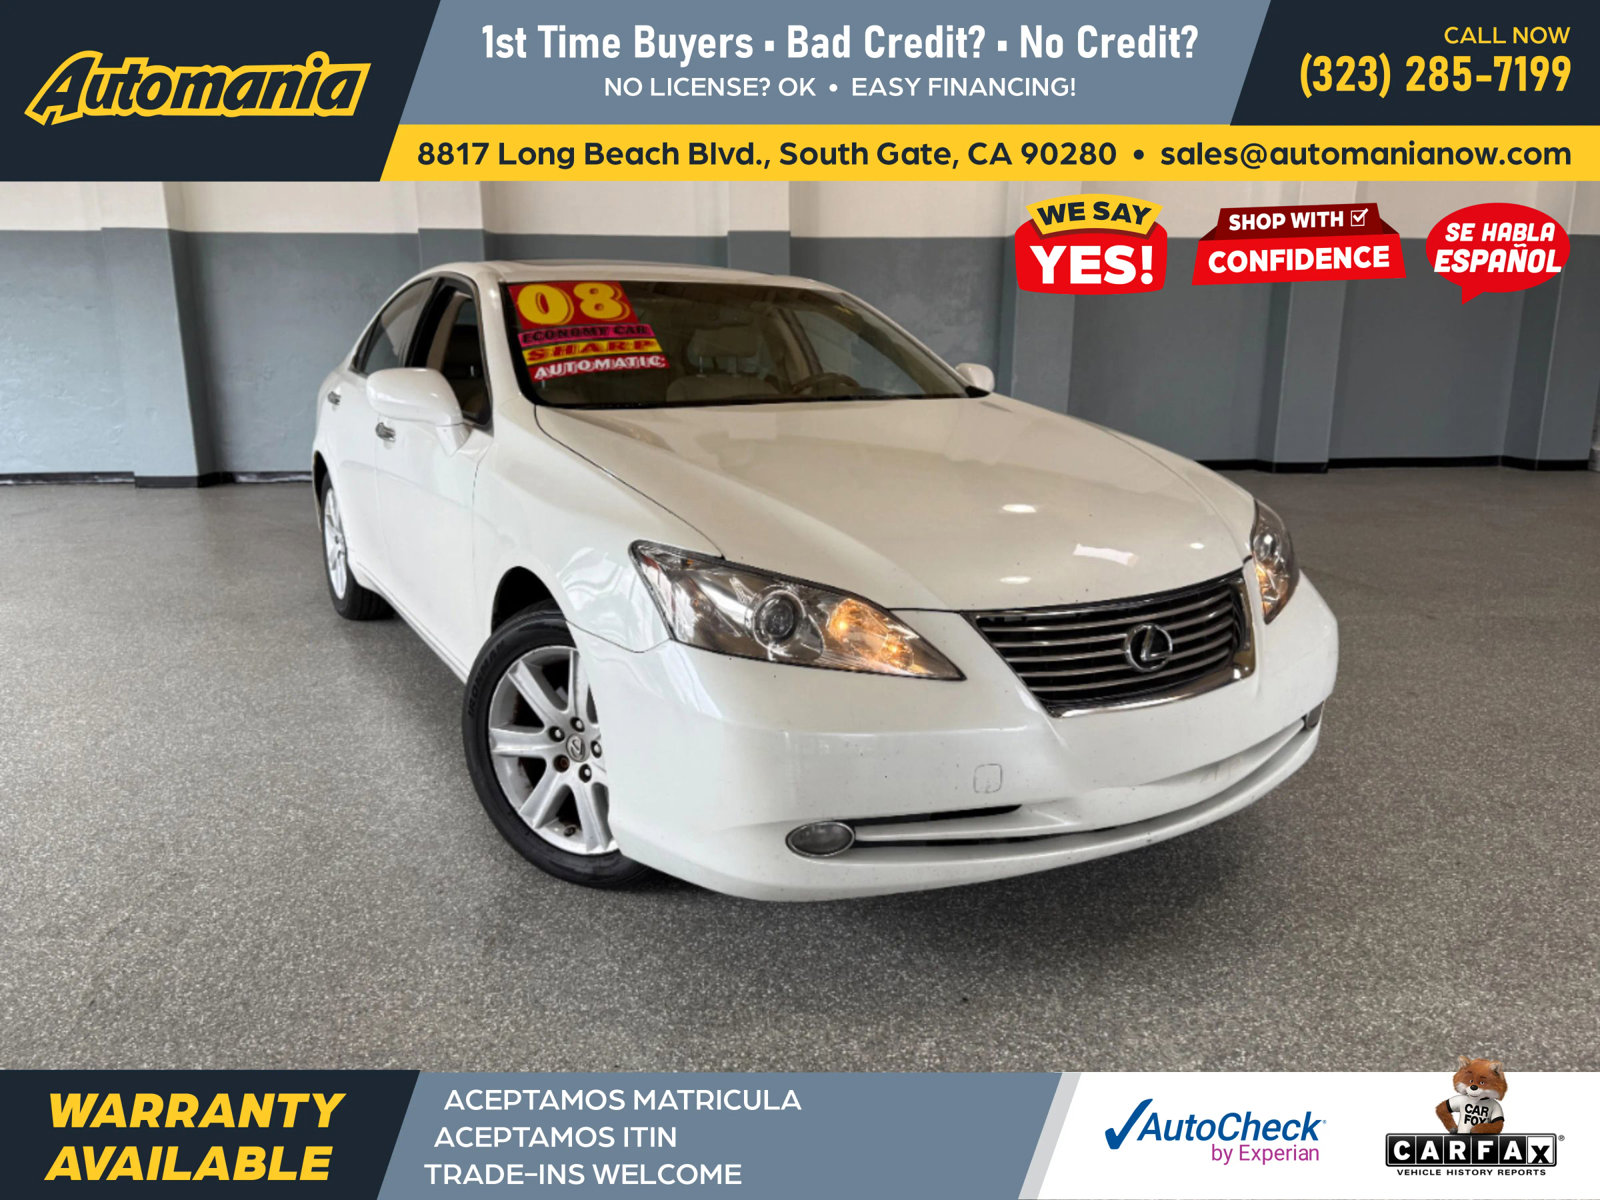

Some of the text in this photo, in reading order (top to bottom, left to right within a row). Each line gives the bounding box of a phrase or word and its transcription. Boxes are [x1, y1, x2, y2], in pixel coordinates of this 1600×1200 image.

[517, 282, 630, 324] 08
[522, 324, 648, 343] ECONOMY CAR
[527, 339, 657, 361] SHARP
[534, 355, 666, 379] AUTOMATIC
